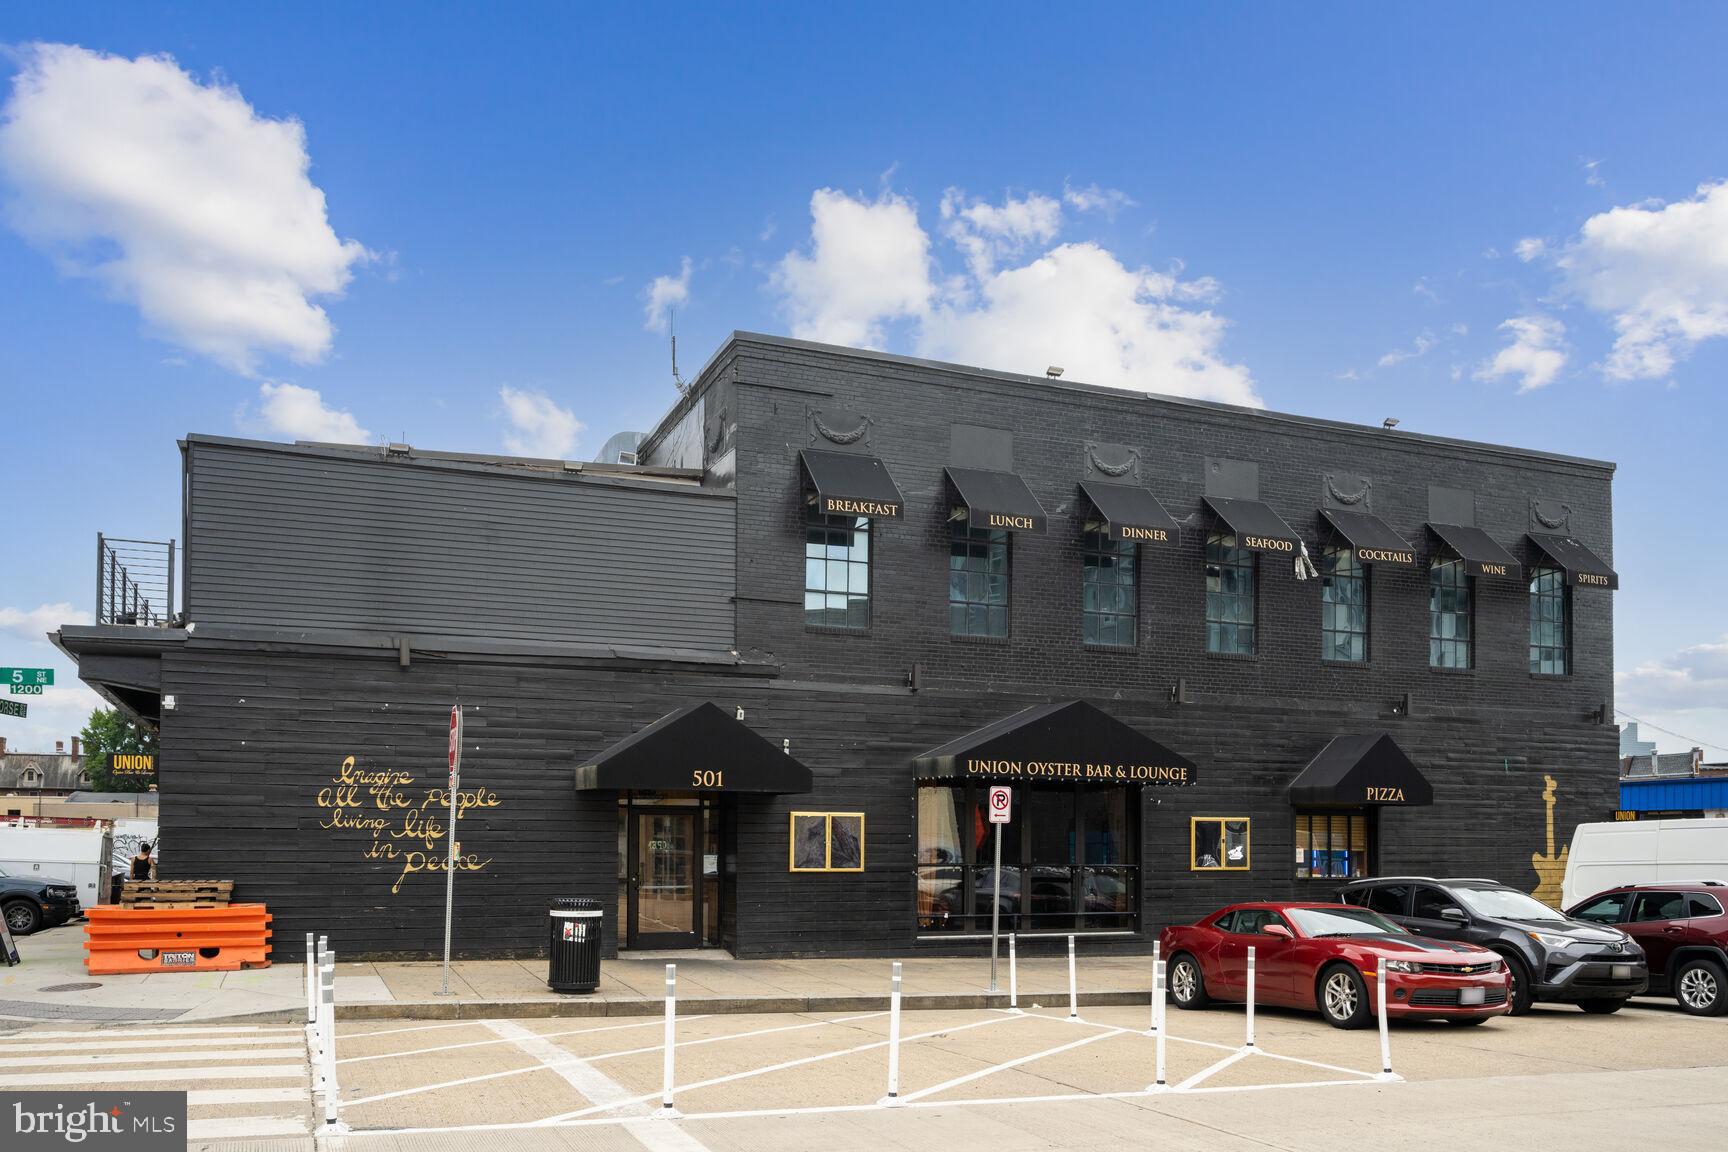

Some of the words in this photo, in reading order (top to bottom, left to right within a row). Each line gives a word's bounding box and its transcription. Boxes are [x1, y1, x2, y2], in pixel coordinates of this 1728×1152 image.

[827, 499, 898, 516] BREAKFAST
[990, 514, 1033, 529] LUNCH
[1122, 526, 1168, 541] DINNER
[1245, 536, 1293, 551] SEAFOOD
[1359, 549, 1413, 563] COCKTAILS
[1482, 563, 1507, 576] WINE
[1578, 573, 1608, 586] SPIRITS
[12, 670, 23, 683] 5
[11, 684, 42, 694] 1200
[113, 755, 151, 769] UNION
[333, 756, 414, 794] Imagine
[968, 760, 1022, 774] UNION
[1027, 762, 1082, 777] OYSTER
[1086, 764, 1113, 778] BAR
[1116, 765, 1126, 778] &
[1130, 766, 1188, 780] LOUNGE
[692, 770, 725, 787] 501
[1366, 787, 1406, 801] PIZZA
[1616, 810, 1635, 821] UNION
[320, 809, 390, 837] living
[390, 809, 447, 850] life
[364, 841, 401, 859] in
